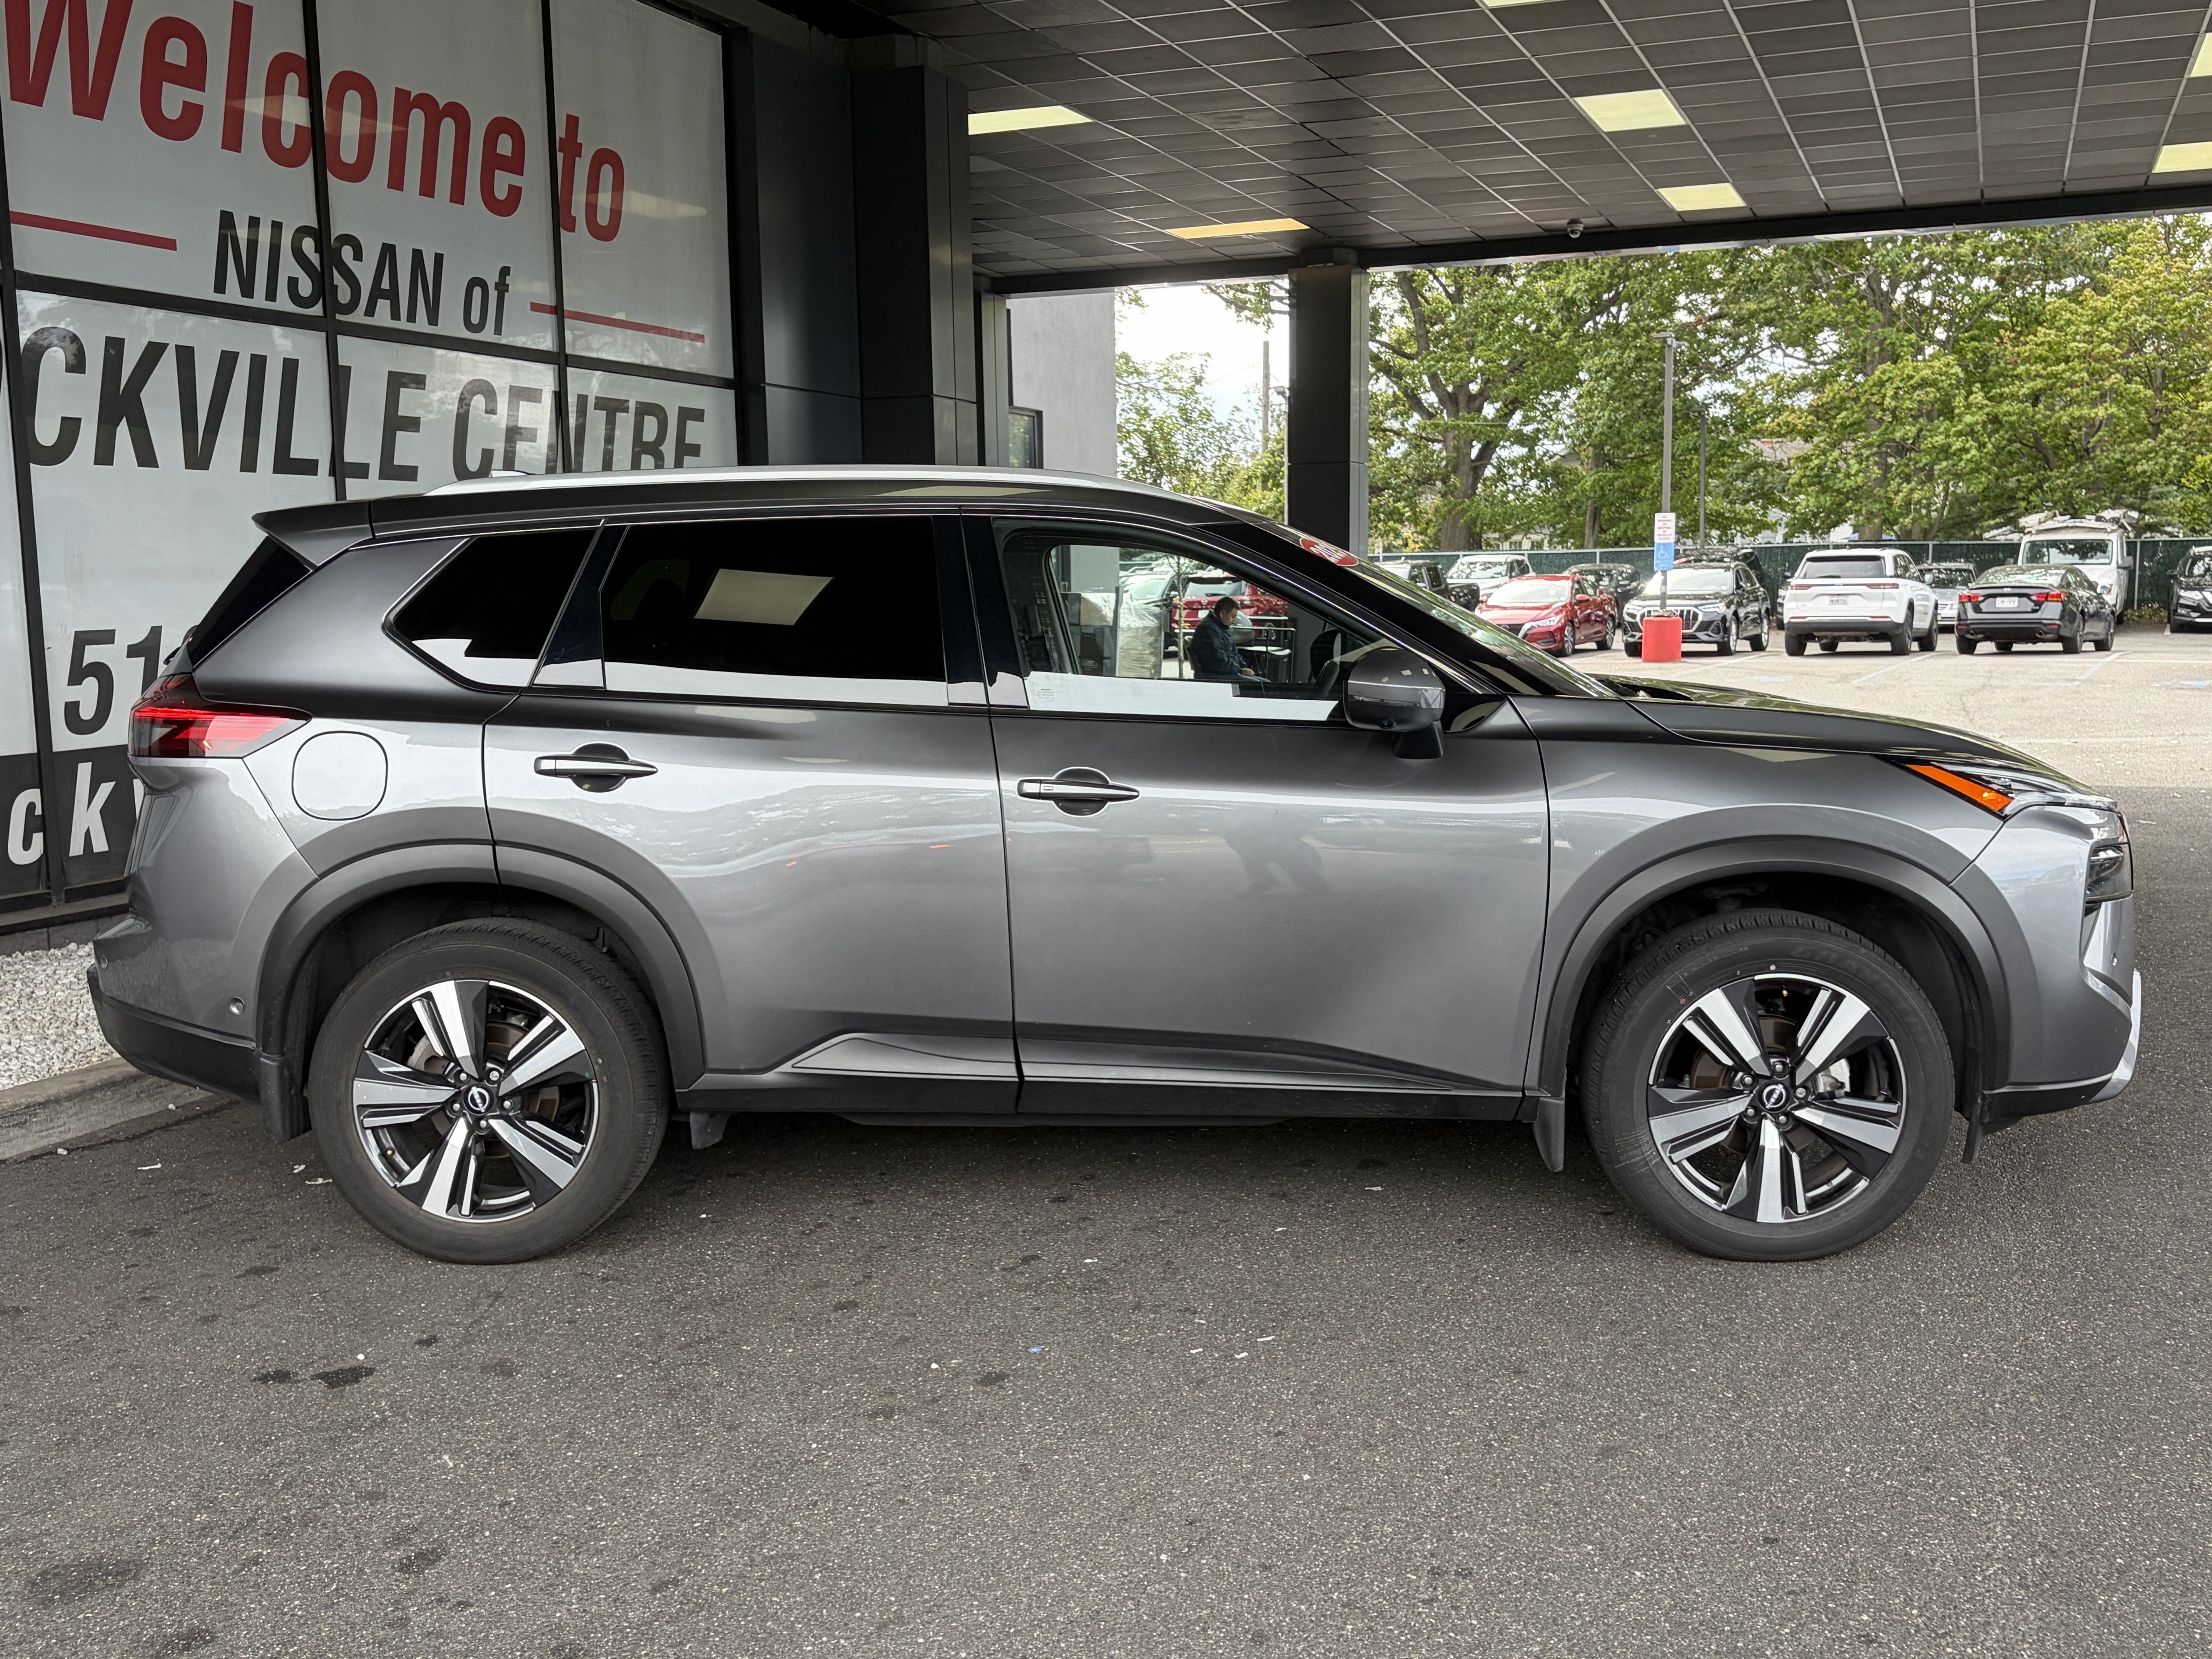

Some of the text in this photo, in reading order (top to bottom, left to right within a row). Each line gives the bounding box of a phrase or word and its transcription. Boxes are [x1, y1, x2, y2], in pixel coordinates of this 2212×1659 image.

[4, 0, 625, 242] Welcome to
[213, 210, 511, 336] NISSAN of
[0, 326, 705, 482] CKVILLE CENTRE
[7, 761, 144, 866] ck
